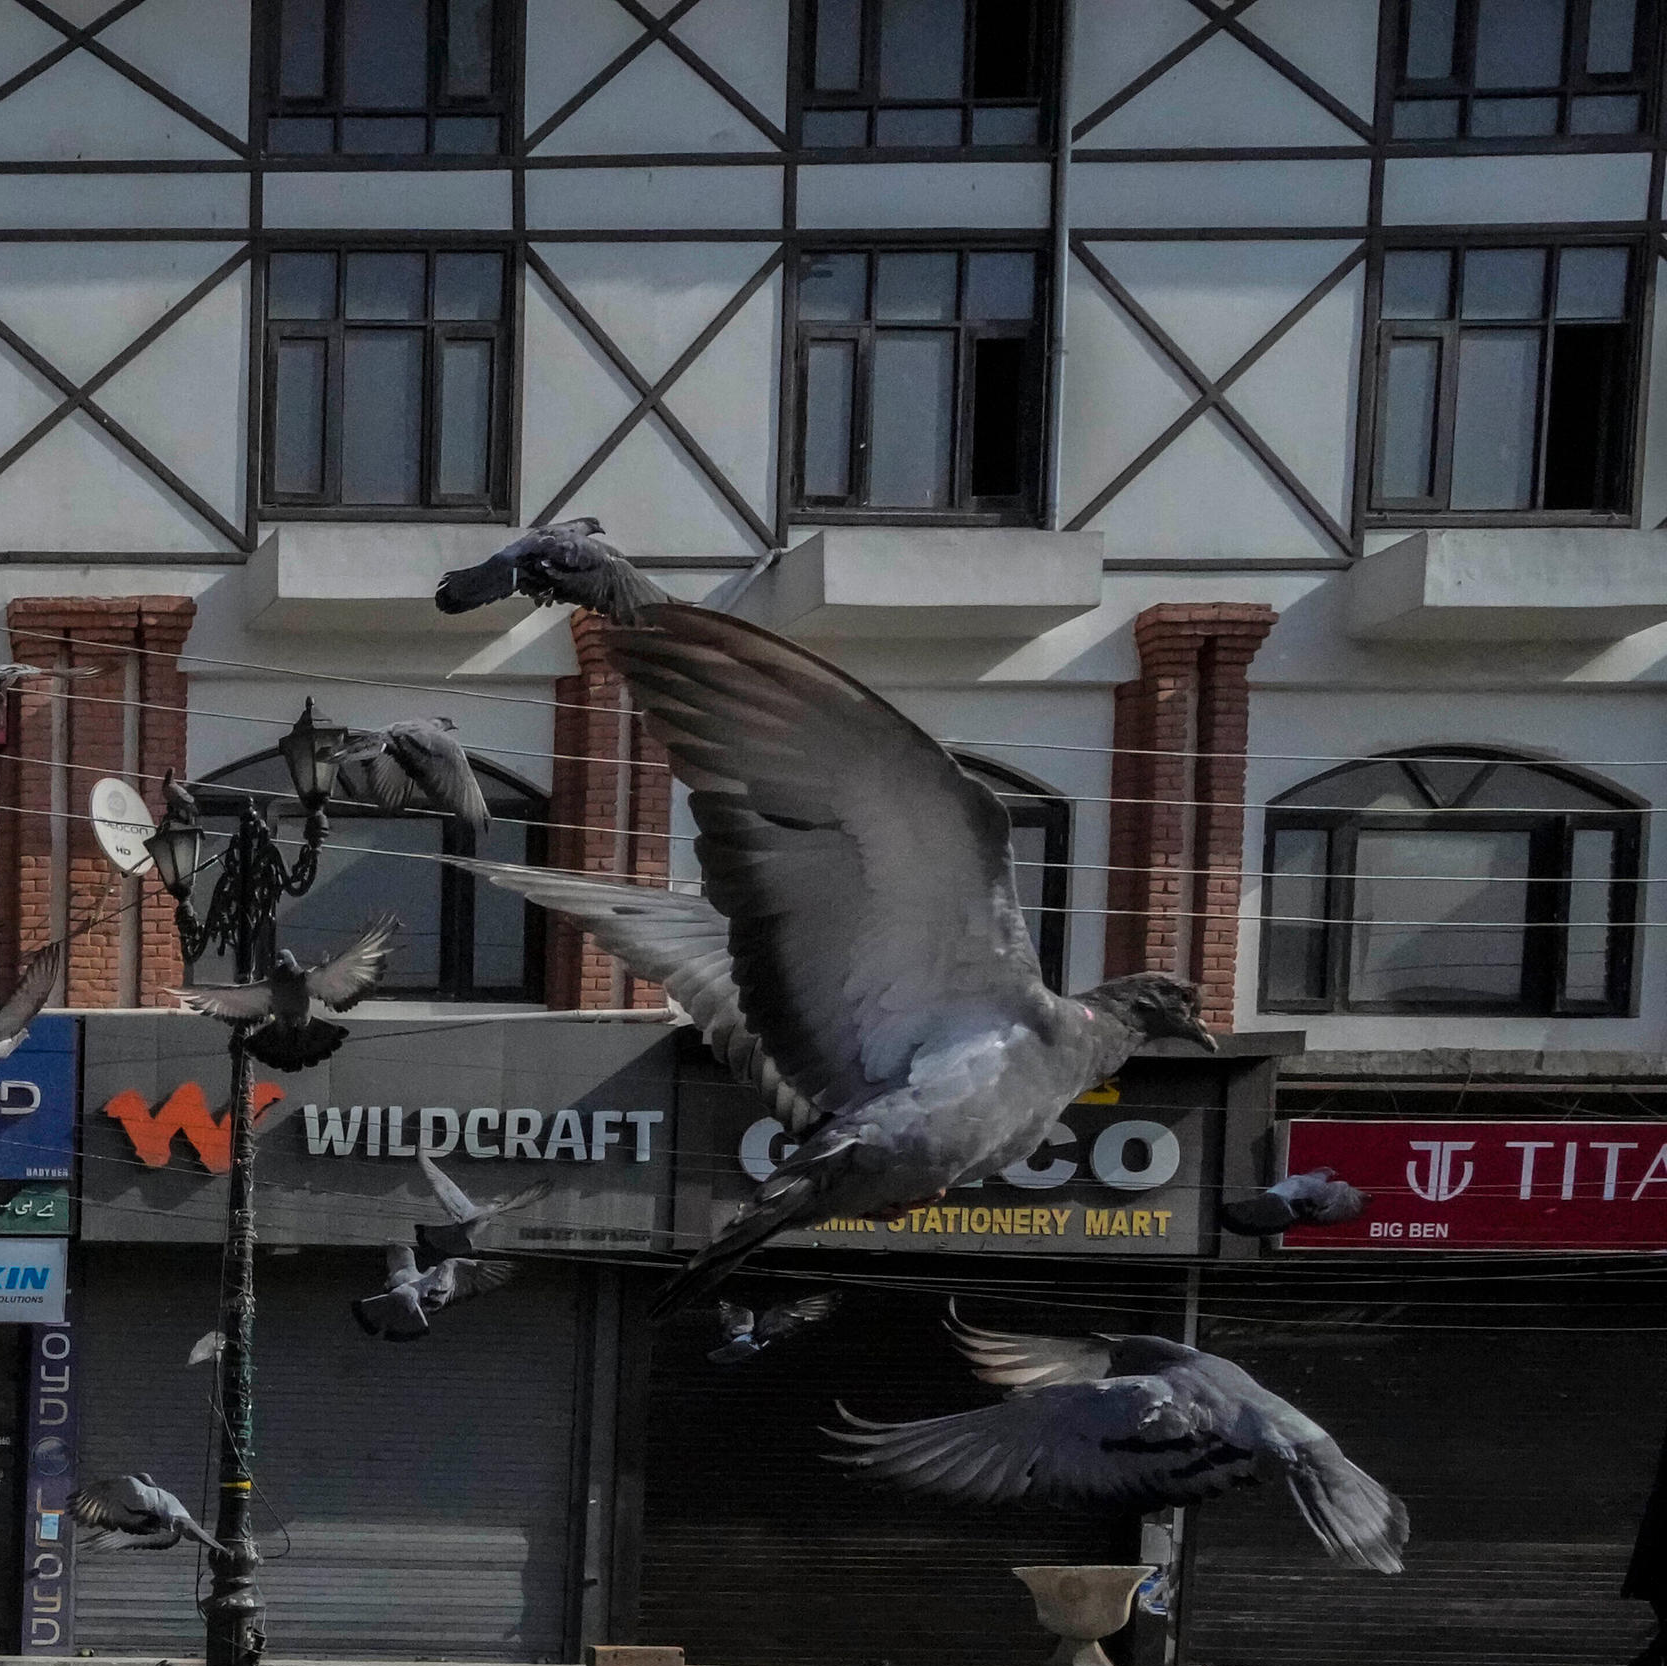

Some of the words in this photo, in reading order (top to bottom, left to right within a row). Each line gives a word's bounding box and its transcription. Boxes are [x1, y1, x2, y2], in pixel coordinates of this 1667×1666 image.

[303, 1103, 663, 1162] WILDCRAFT
[887, 1207, 1072, 1235] STATIONERY
[1084, 1210, 1171, 1237] MART
[1369, 1223, 1403, 1238] BIG
[1408, 1223, 1449, 1239] BEN
